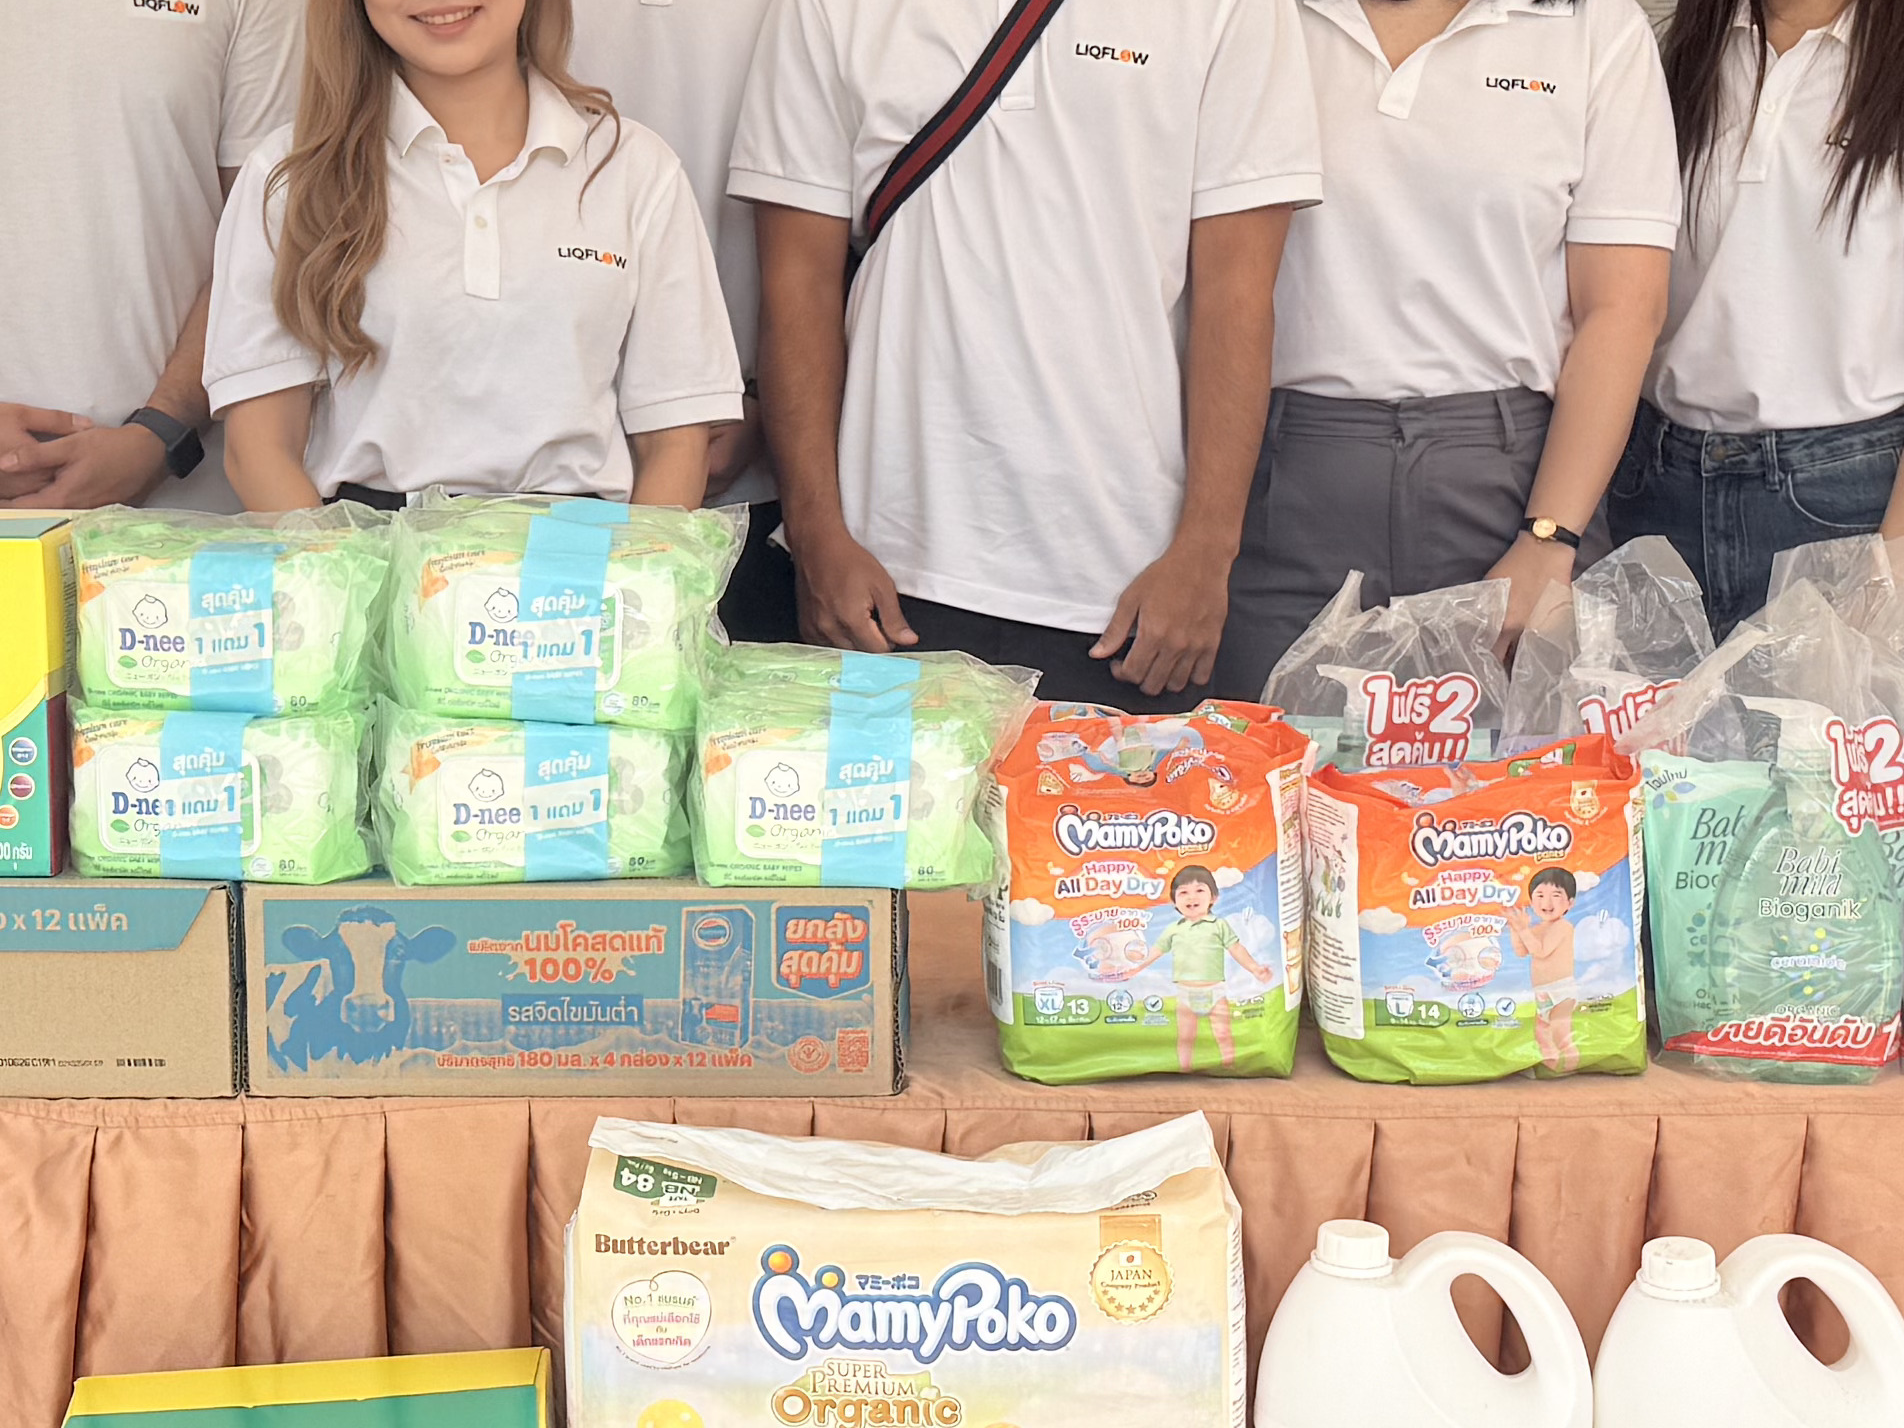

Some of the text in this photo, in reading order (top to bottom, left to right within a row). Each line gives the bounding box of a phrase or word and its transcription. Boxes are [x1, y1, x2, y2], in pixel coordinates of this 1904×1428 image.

[1075, 42, 1150, 66] LIQFLOW
[1485, 76, 1557, 96] LIQFLOW
[557, 246, 628, 270] LIQFLOW
[201, 585, 255, 610] สุดคุ้ม
[119, 628, 185, 653] D-nee
[195, 622, 265, 654] 1 แถม 1
[538, 751, 591, 780] สุดคุ้ม
[453, 803, 521, 825] D-nee
[749, 797, 816, 821] D-nee
[1058, 811, 1214, 856] MamyPoko
[1413, 813, 1571, 864] MamyPoko
[12, 845, 32, 870] กรัม
[1085, 862, 1135, 876] Happy
[1776, 847, 1842, 875] Babi
[1057, 878, 1162, 897] All Day Dry
[13, 914, 25, 929] x
[32, 909, 61, 930] 12
[68, 904, 128, 931] แพ็ค
[1759, 899, 1862, 921] Bioganik
[785, 913, 868, 943] ยกลัง
[522, 957, 614, 983] 100%
[780, 946, 864, 987] สุดคุ้ม
[507, 996, 639, 1023] รสจืดไขมันต่ำ
[595, 1234, 730, 1257] Butterbear
[1111, 1270, 1152, 1281] JAPAN
[757, 1264, 1076, 1361] MamyPoko
[809, 1367, 915, 1396] PREMIUM
[824, 1362, 886, 1380] SUPER
